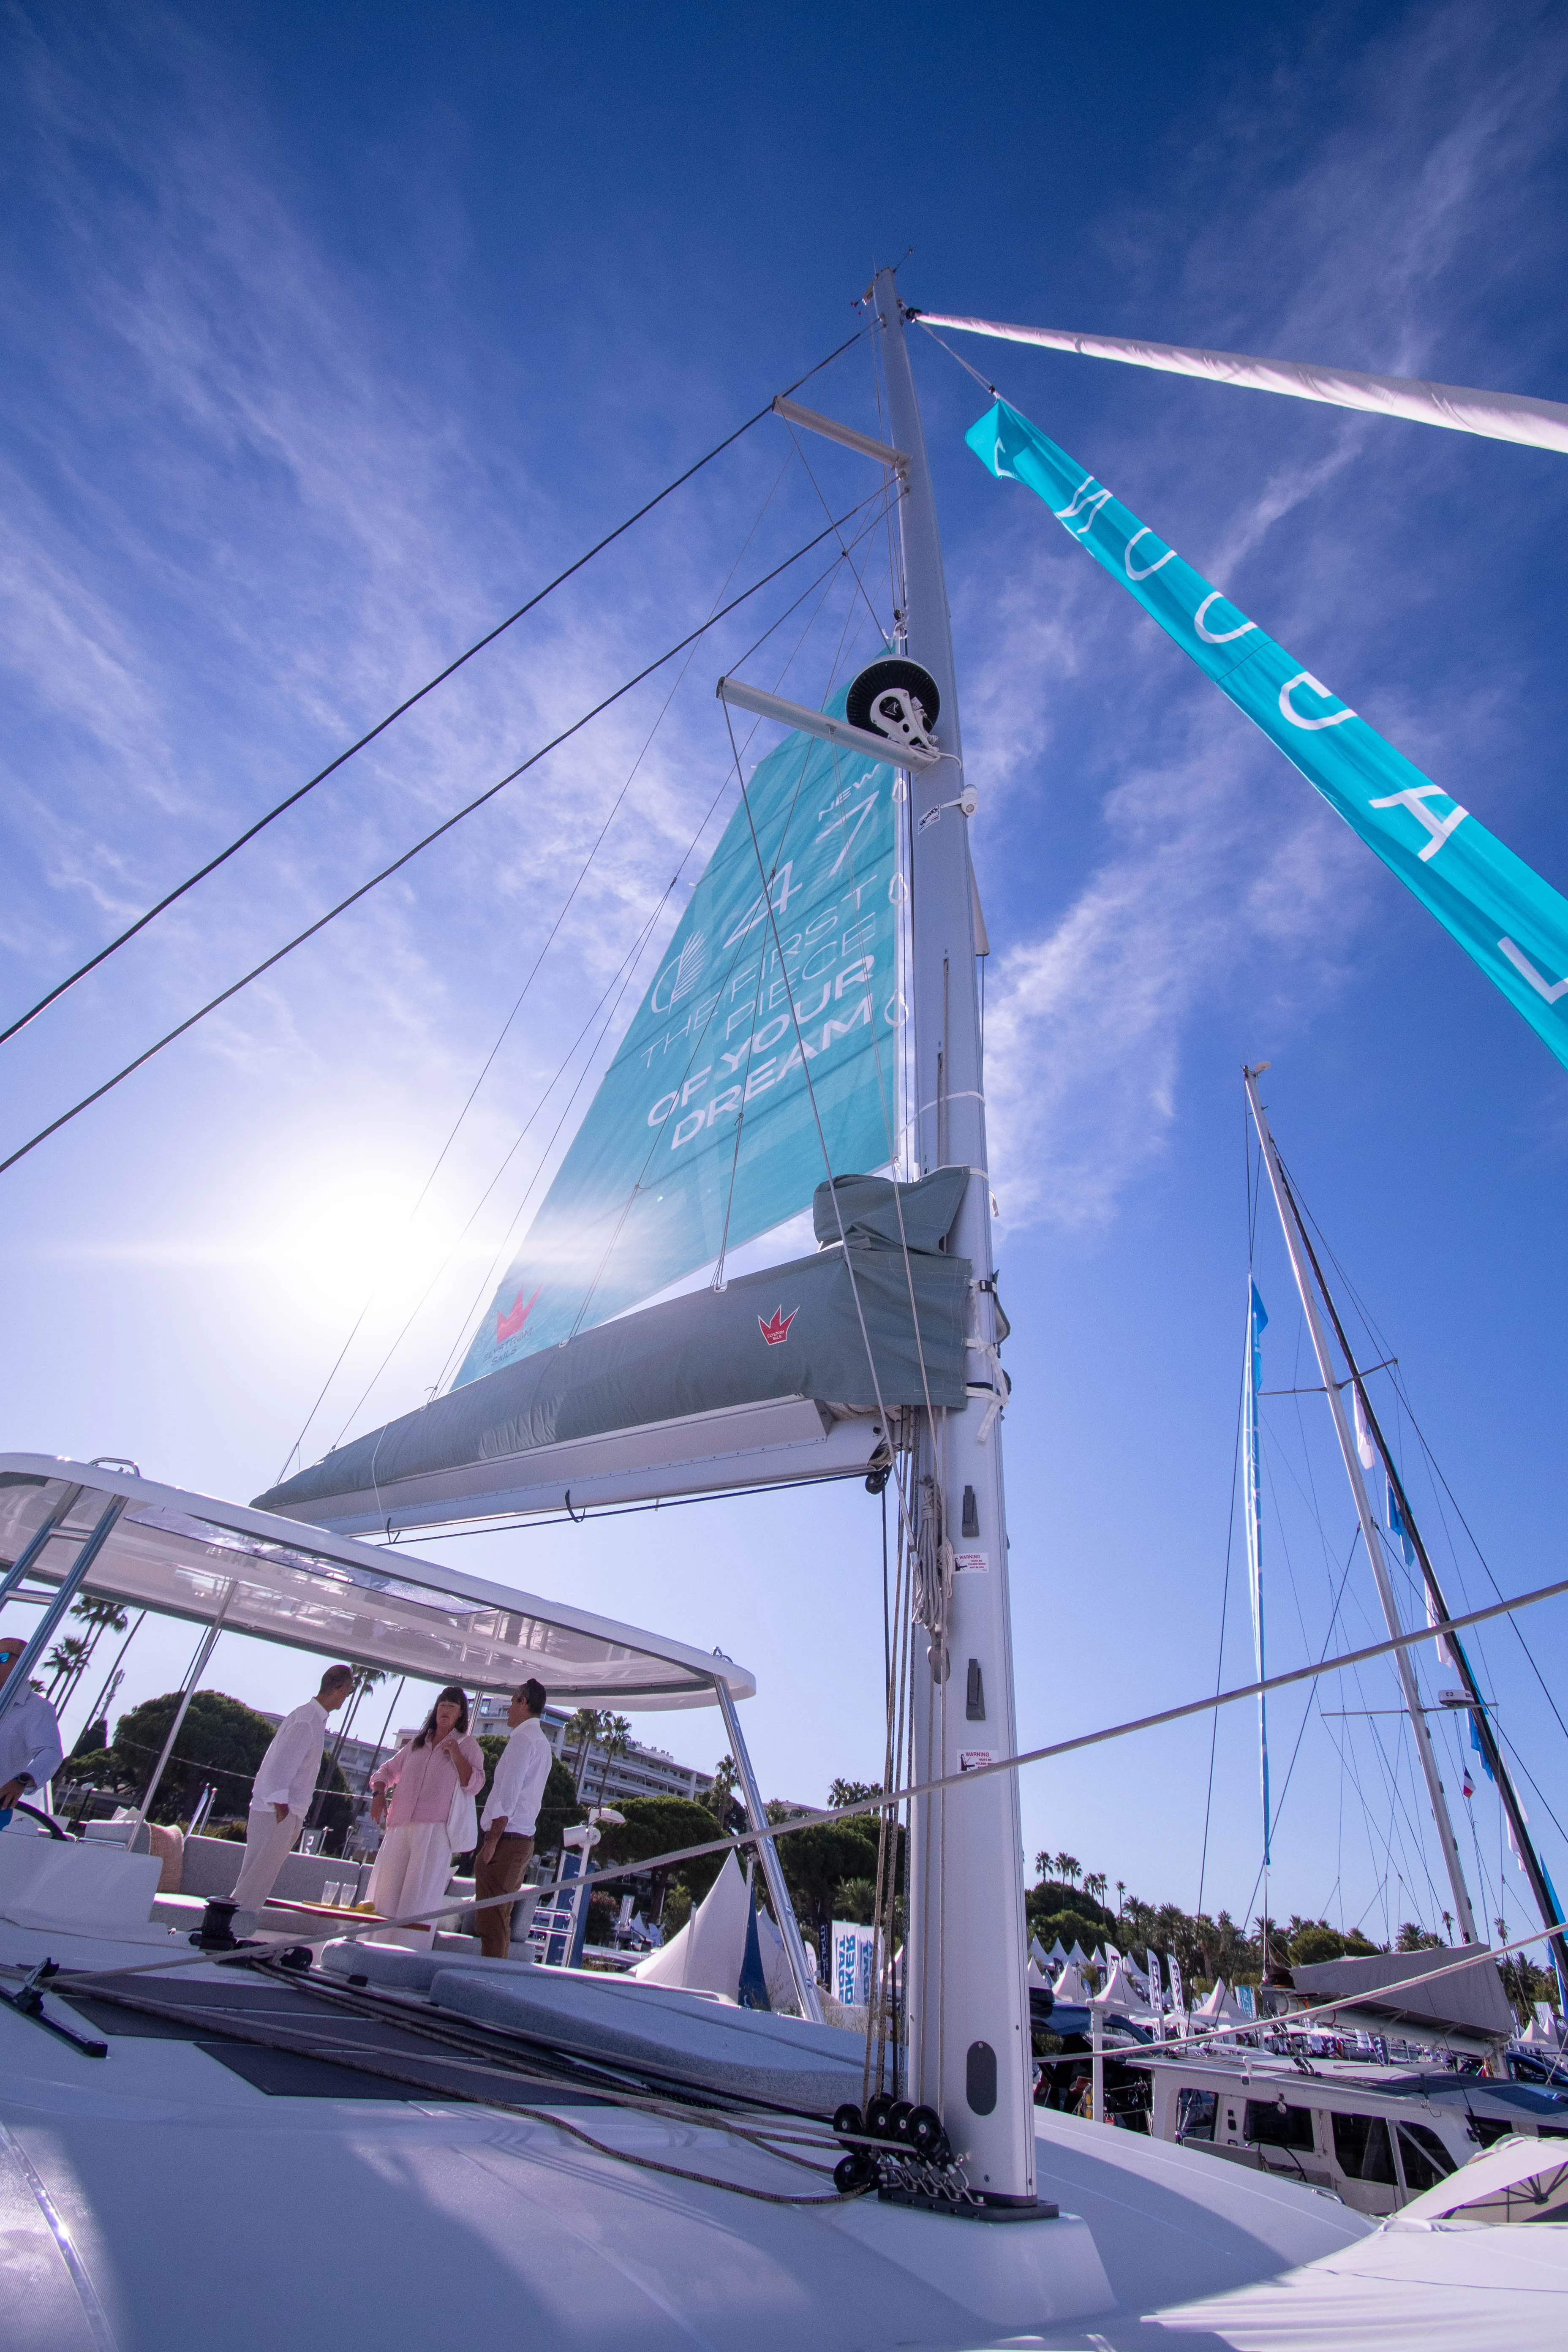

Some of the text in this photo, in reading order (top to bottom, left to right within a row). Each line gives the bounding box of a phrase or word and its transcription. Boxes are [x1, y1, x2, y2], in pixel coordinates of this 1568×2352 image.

[818, 763, 880, 822] NEW
[640, 875, 877, 1068] THE FIRST
[647, 955, 875, 1127] OF YOUR
[726, 912, 876, 1041] PIECE
[671, 992, 872, 1151] DREAM
[491, 1345, 517, 1366] SAILS
